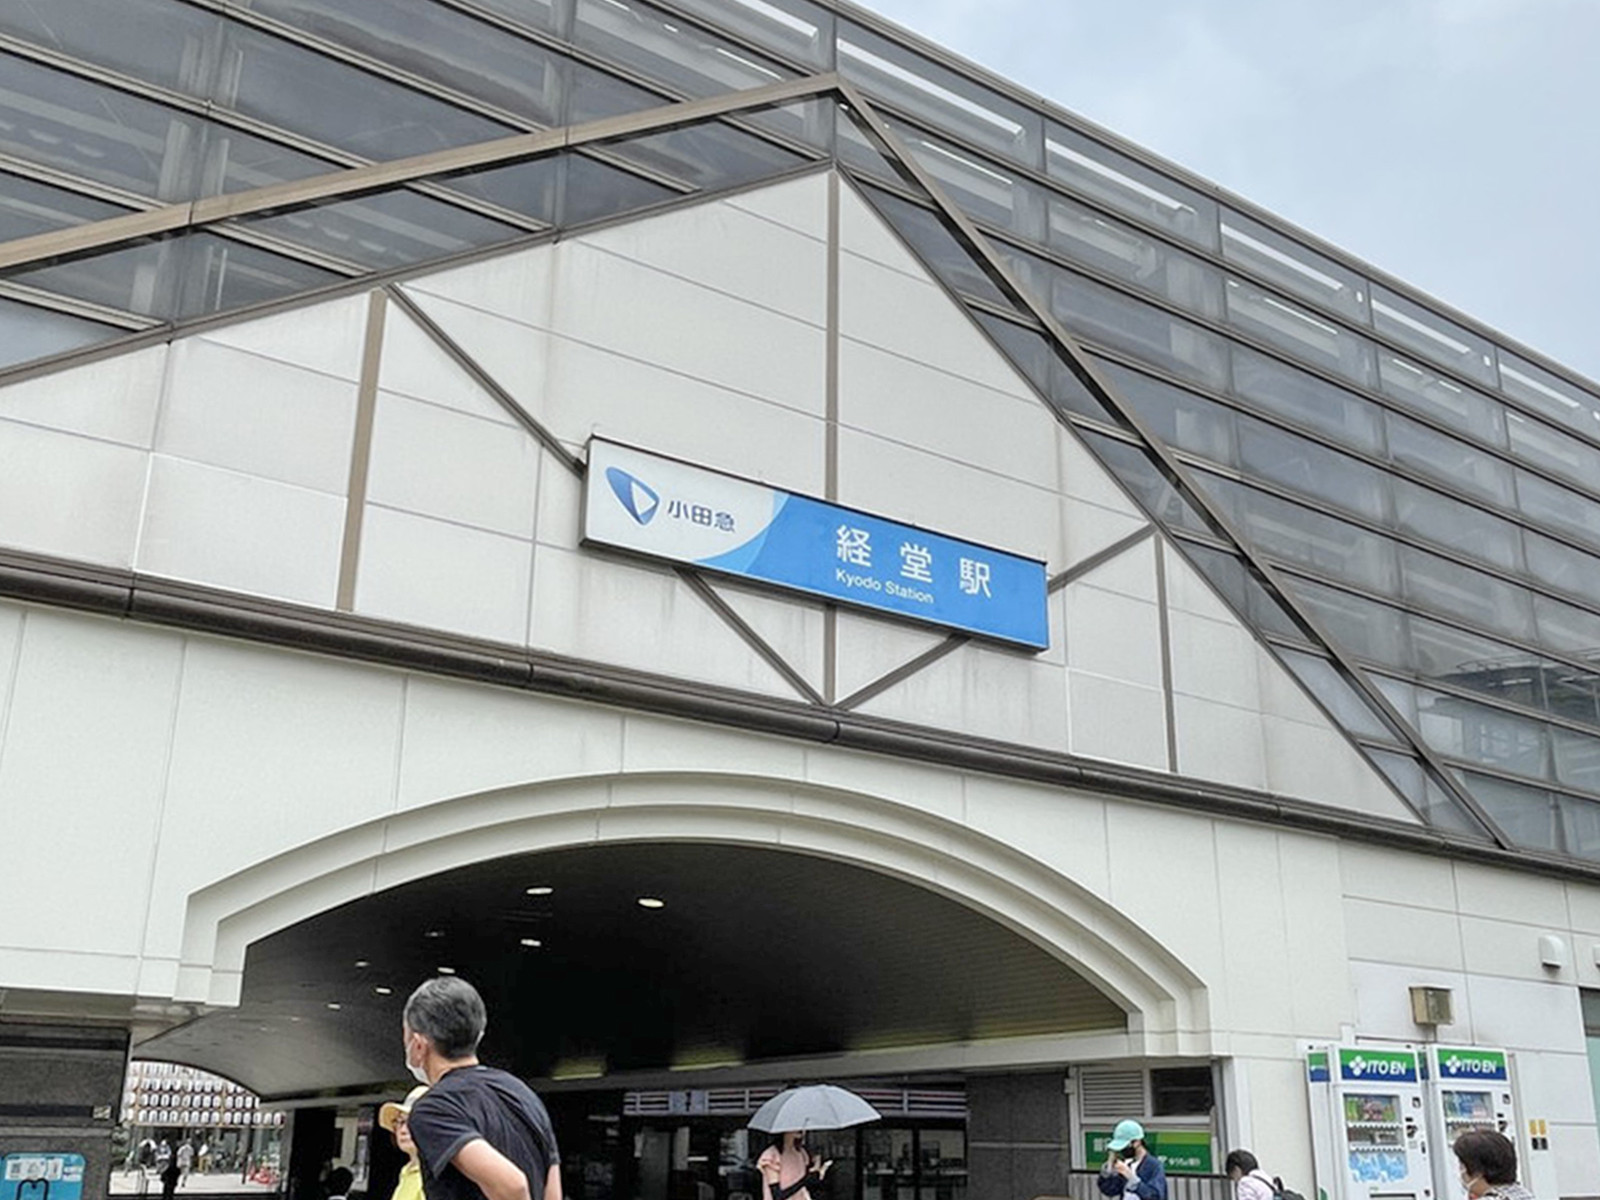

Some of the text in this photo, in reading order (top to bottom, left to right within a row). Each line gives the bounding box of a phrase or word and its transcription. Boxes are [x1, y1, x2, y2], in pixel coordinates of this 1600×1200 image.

[667, 500, 736, 533] 小田急
[836, 524, 992, 599] 経堂駅
[836, 568, 935, 604] Kyodo Station
[1366, 1059, 1407, 1076] ITO EN
[1460, 1059, 1497, 1074] ITO EN
